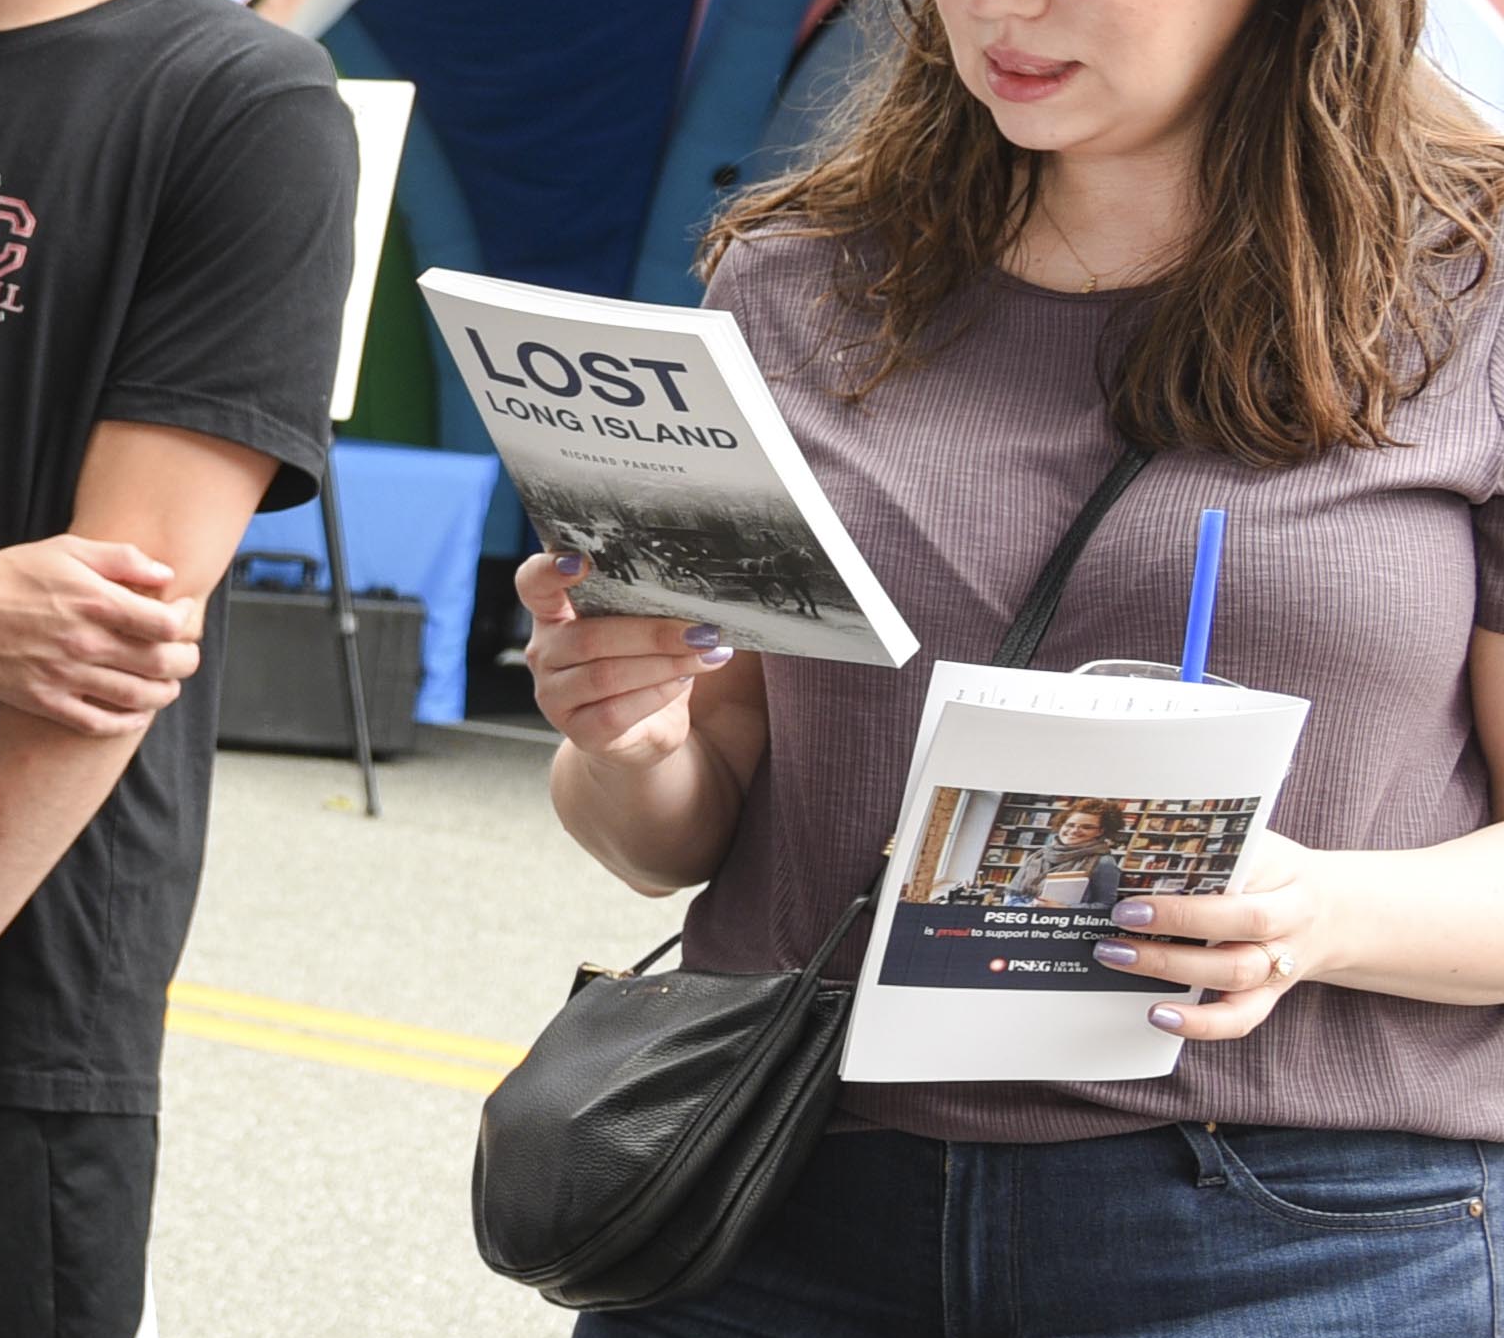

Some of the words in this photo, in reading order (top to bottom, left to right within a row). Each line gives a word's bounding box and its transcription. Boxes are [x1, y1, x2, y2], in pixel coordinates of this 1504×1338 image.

[465, 327, 689, 412] LOST
[486, 391, 584, 432] LONG
[592, 415, 737, 449] ISLAND
[560, 449, 617, 465] RICHARD
[623, 459, 687, 473] PANCHYK
[984, 911, 1028, 925] PSEG
[1030, 913, 1069, 927] Long
[1073, 915, 1115, 927] Islan
[924, 926, 934, 936] is
[971, 928, 983, 937] to
[985, 929, 1028, 940] support
[1031, 929, 1050, 939] the
[1052, 930, 1080, 940] Gold
[1008, 960, 1052, 972] PSEG
